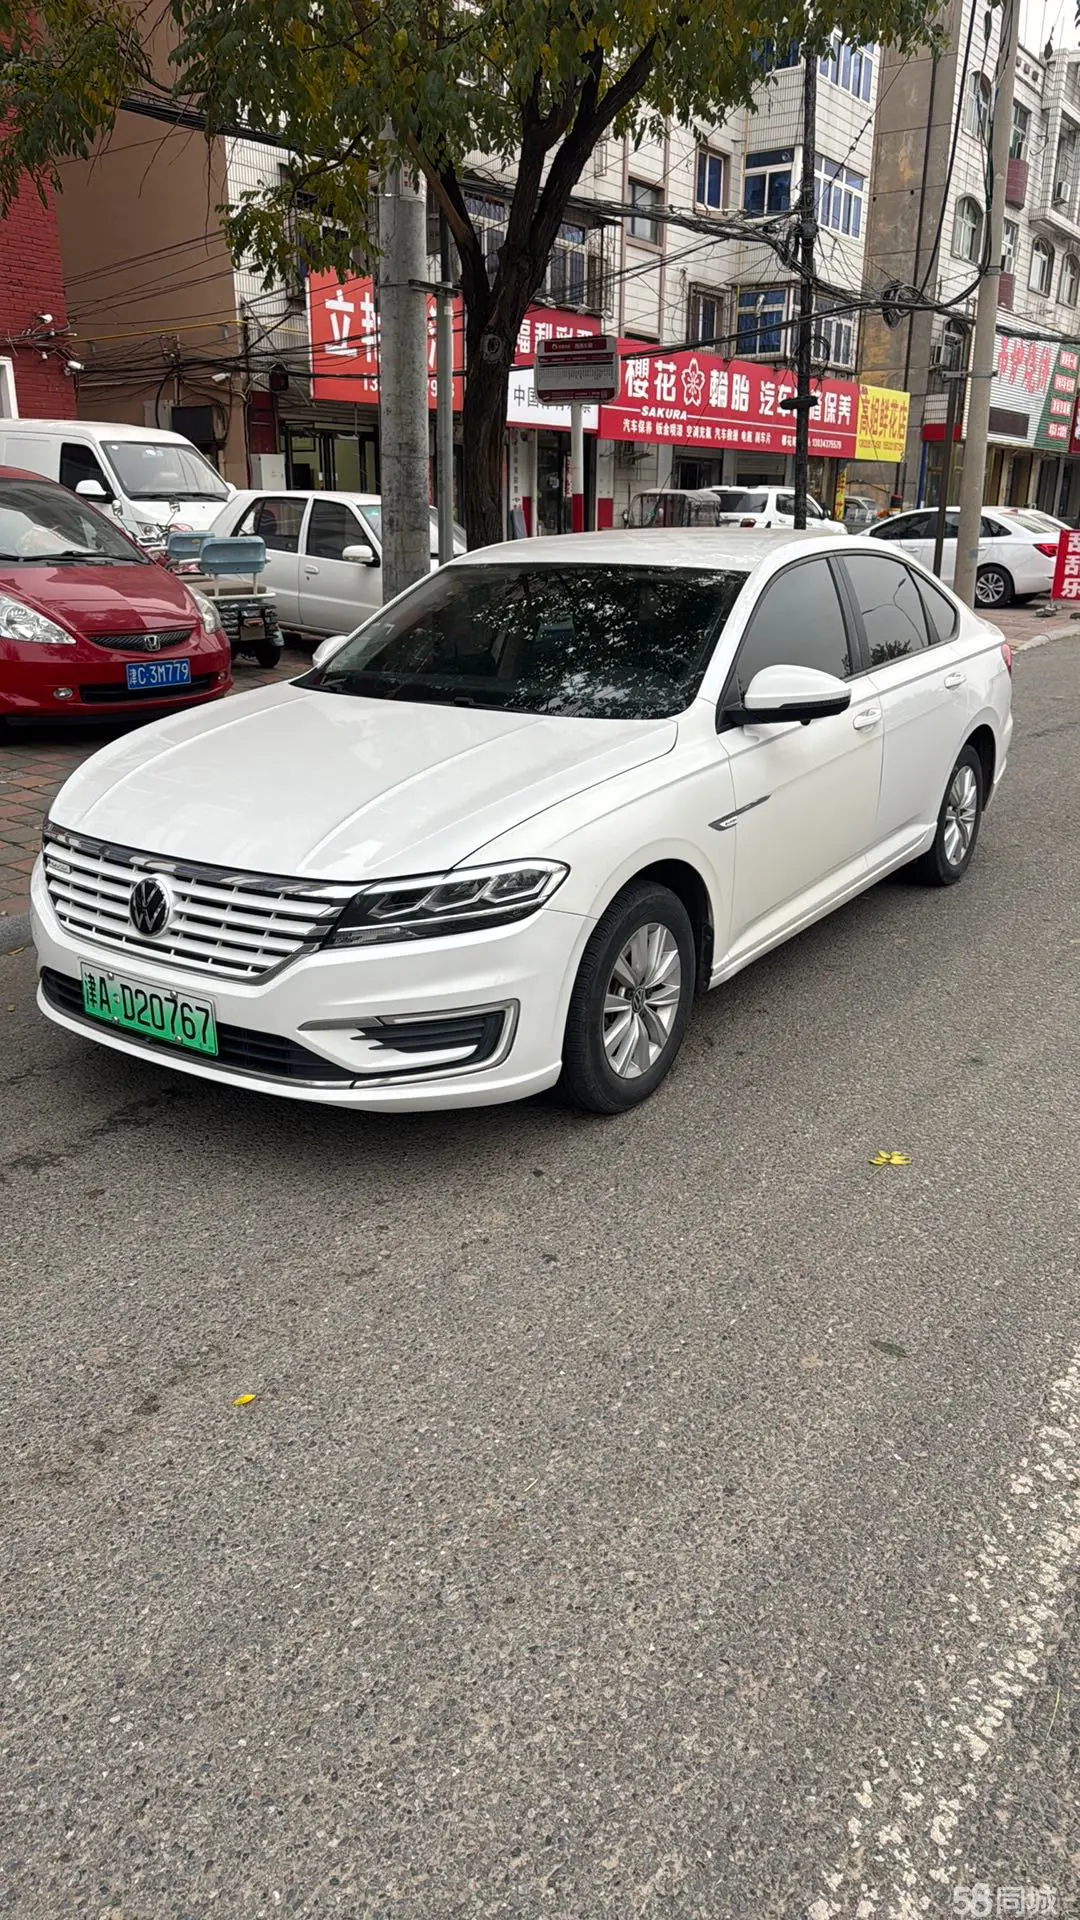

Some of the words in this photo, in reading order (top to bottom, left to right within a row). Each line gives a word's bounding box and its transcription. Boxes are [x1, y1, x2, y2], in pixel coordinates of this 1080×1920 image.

[759, 380, 852, 426] 汽车修保养
[640, 406, 688, 421] SAKURA
[623, 418, 653, 434] 汽车保养
